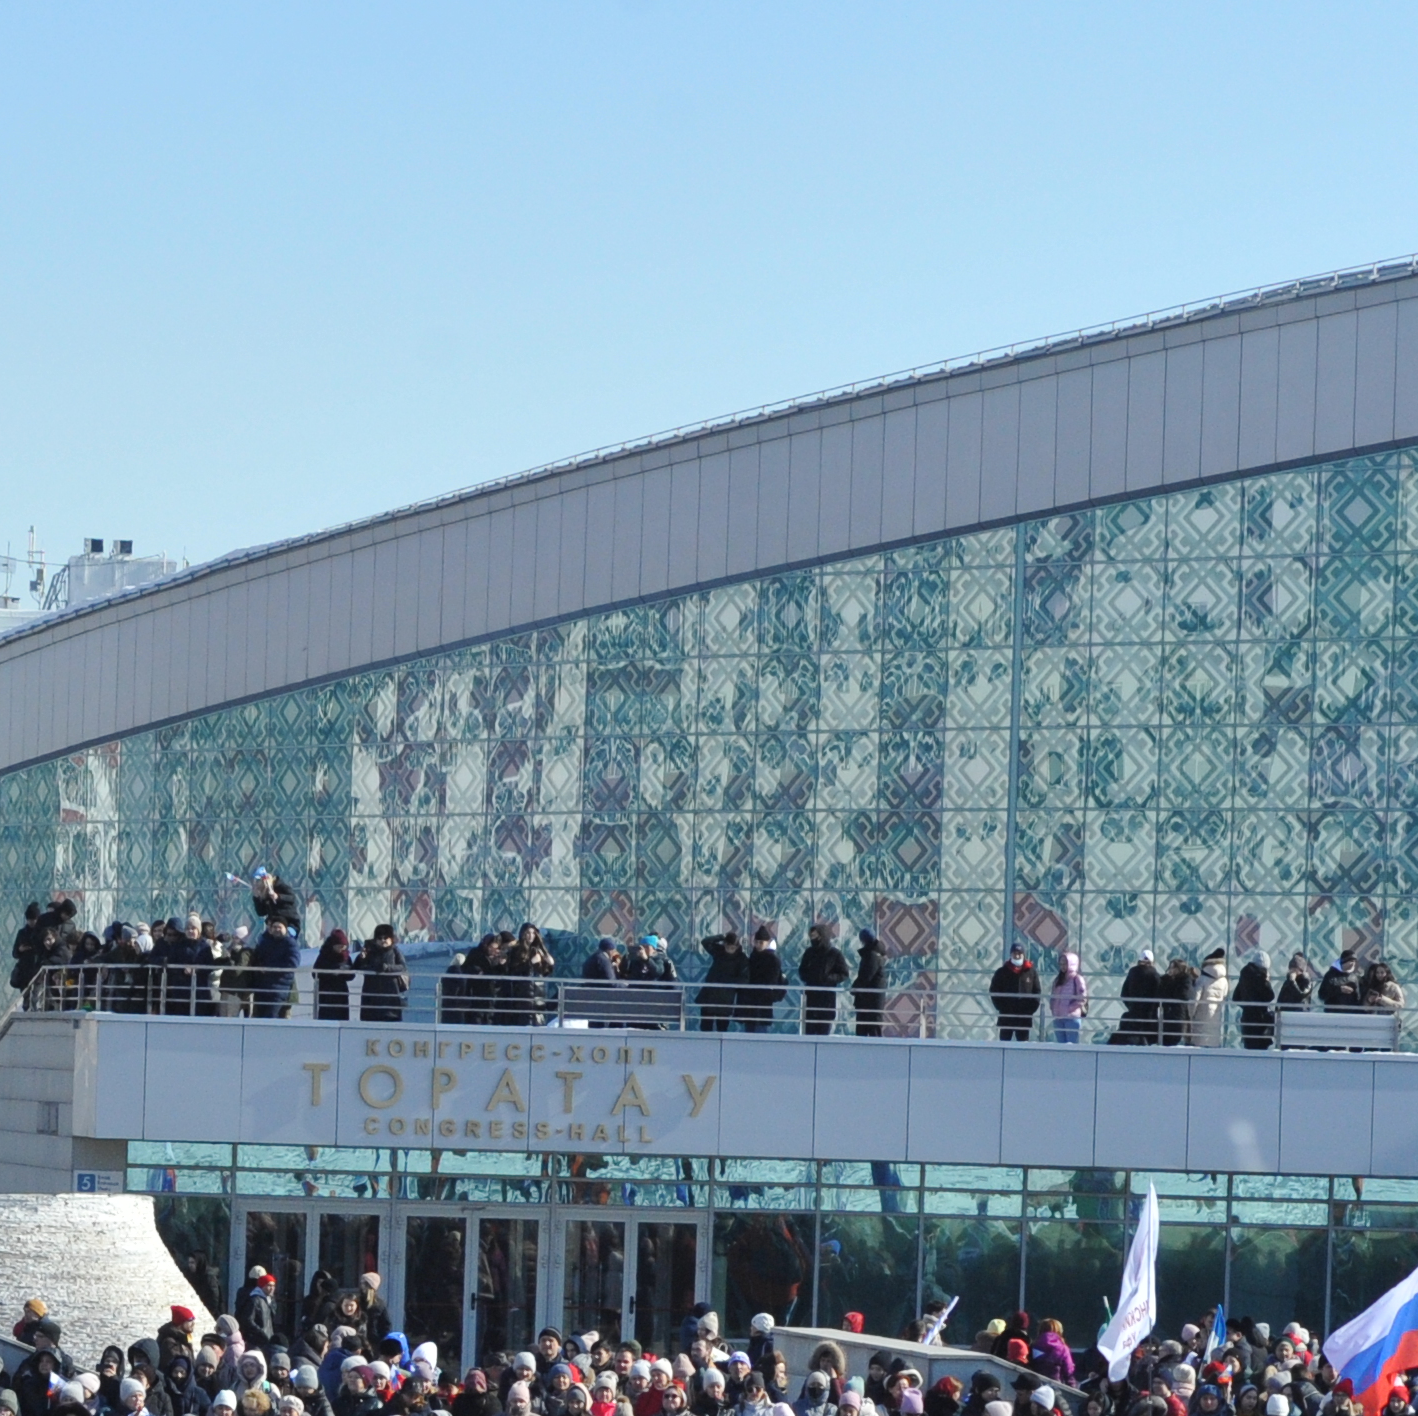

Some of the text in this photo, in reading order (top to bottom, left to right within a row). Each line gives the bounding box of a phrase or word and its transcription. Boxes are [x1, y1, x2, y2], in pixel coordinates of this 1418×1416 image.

[366, 1039, 657, 1065] КОНГРЕСС-ХОЛЛ
[303, 1063, 718, 1118] ТОРАТАУ
[364, 1116, 654, 1143] CONGRESS-HALL
